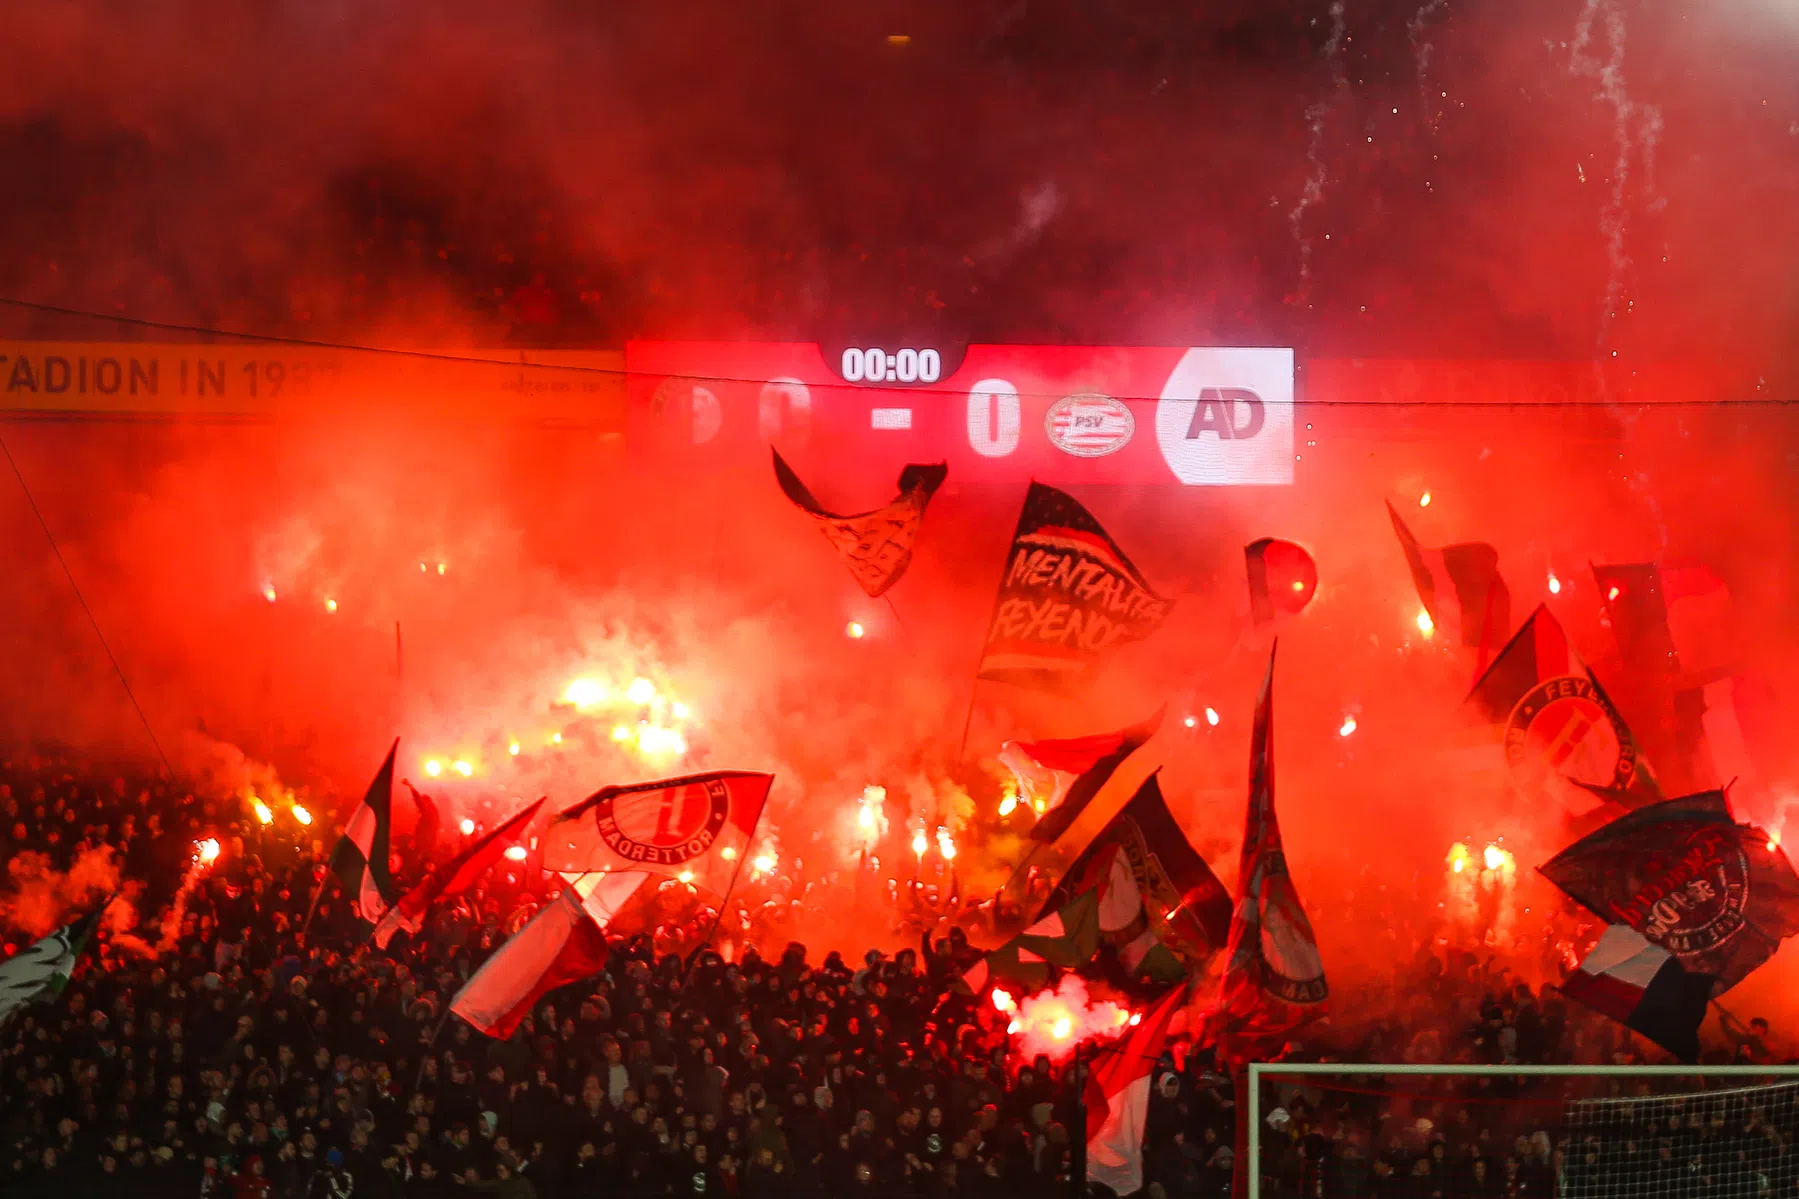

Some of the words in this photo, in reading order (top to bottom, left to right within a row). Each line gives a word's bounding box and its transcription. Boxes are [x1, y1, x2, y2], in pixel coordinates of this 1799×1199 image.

[0, 355, 159, 395] ADION
[180, 359, 225, 398] IN
[243, 359, 341, 398] 19
[841, 347, 941, 383] 00:00
[967, 378, 1021, 458] 0
[1075, 415, 1104, 428] PSV
[1185, 387, 1265, 440] AD
